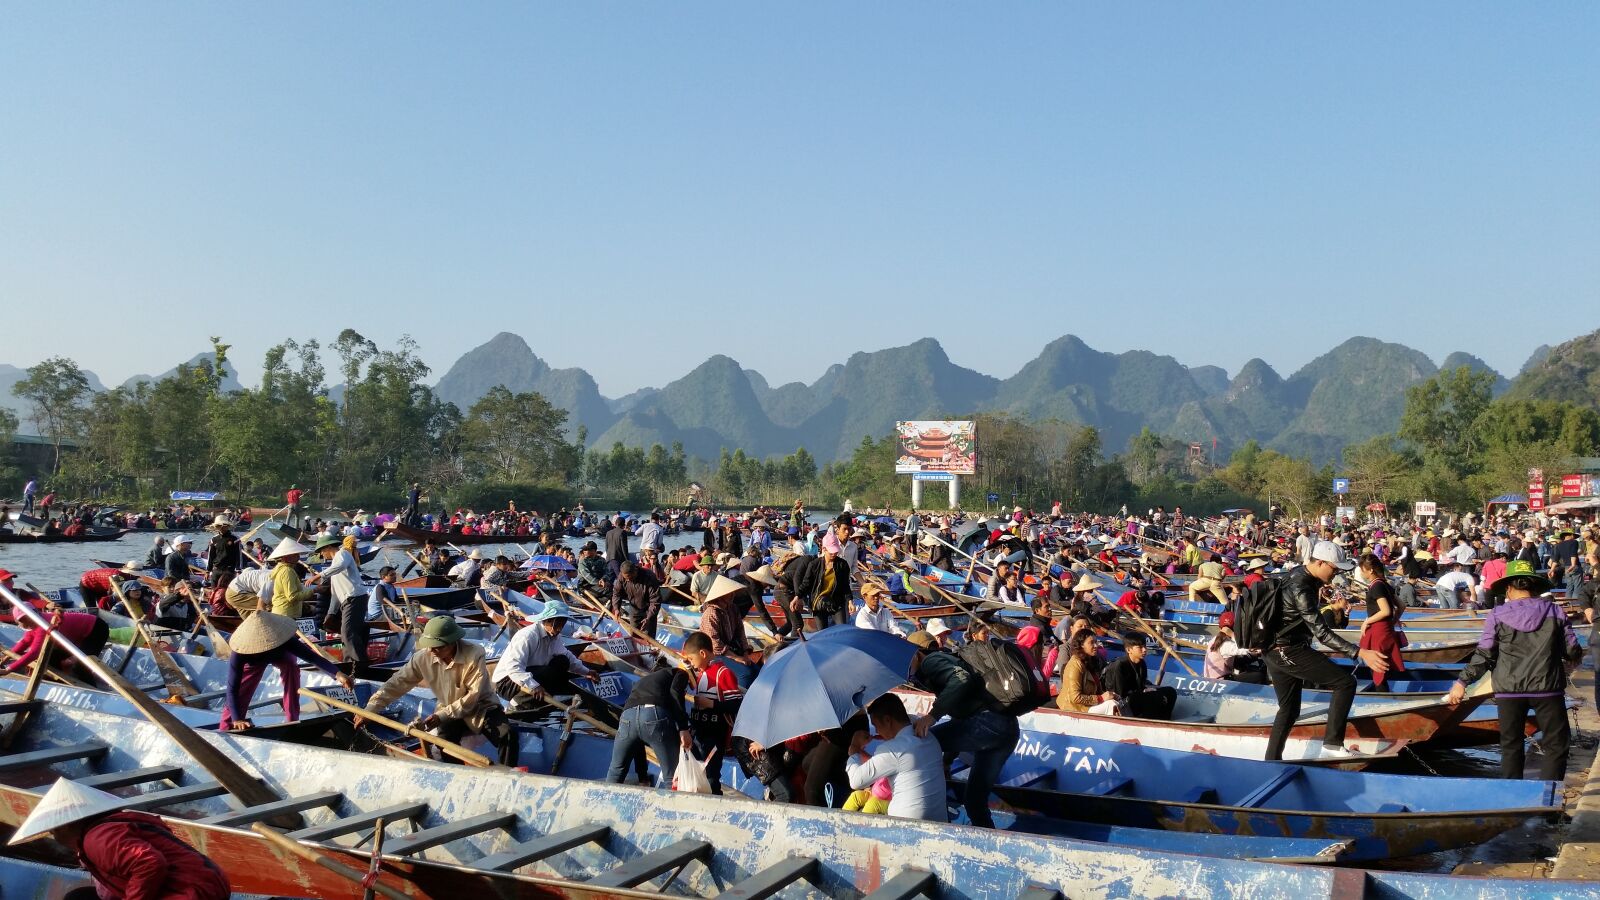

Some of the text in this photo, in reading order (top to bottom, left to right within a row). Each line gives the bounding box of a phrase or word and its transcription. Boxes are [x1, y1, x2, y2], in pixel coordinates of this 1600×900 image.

[1336, 482, 1345, 490] P
[611, 645, 629, 655] 0239
[1063, 746, 1120, 774] TÂM
